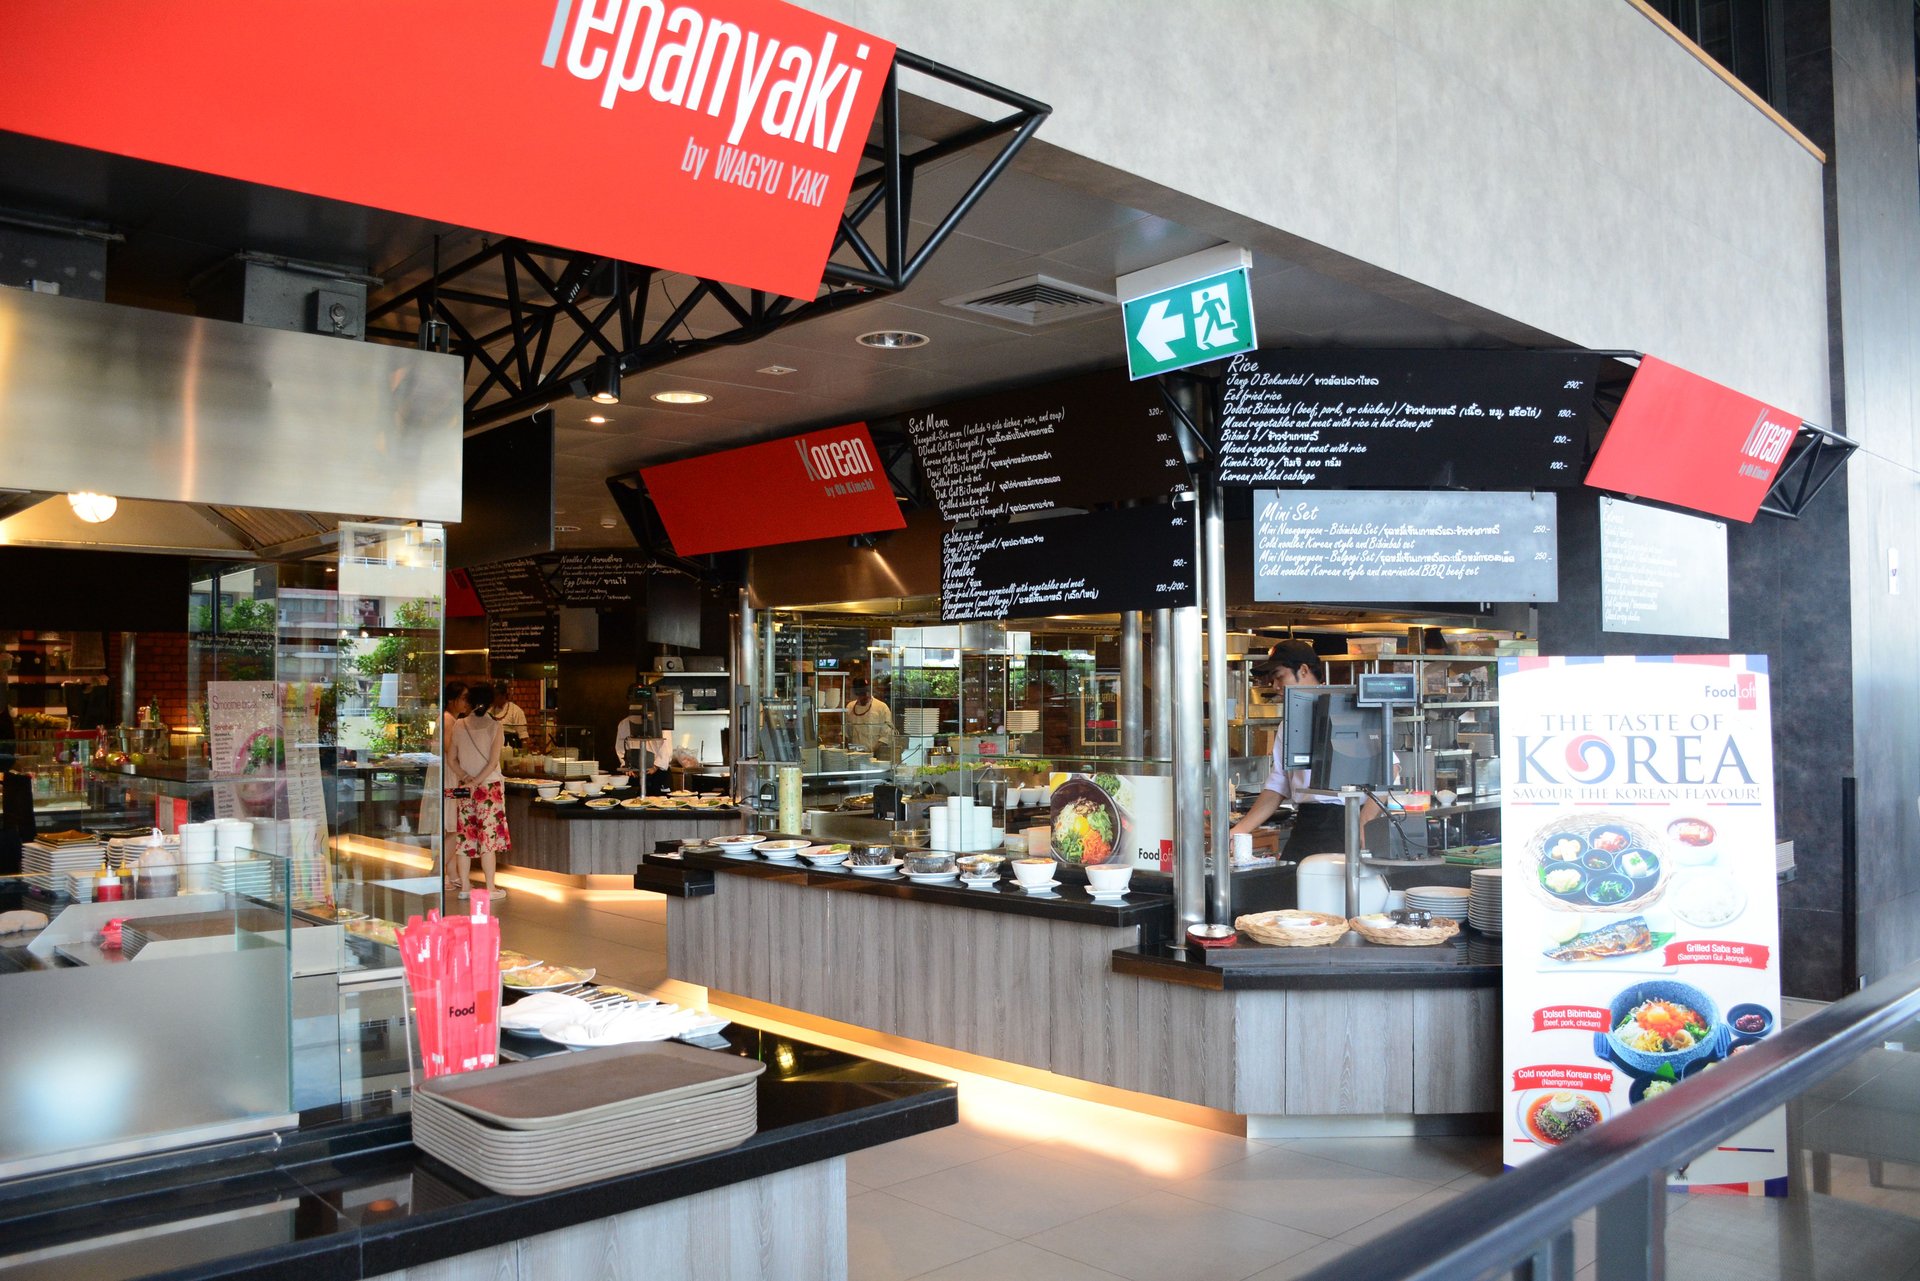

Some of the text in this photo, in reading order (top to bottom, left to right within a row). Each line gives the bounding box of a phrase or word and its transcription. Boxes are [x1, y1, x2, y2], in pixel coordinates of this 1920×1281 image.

[681, 136, 830, 208] by WAGYU YAKI
[1228, 354, 1259, 373] Rice
[1226, 373, 1249, 389] Jang
[1224, 389, 1282, 405] Eel fried rice
[1223, 403, 1253, 415] Dolsot
[1252, 402, 1291, 415] Bibimbab
[1319, 402, 1343, 418] pork,
[1357, 401, 1397, 416] chicken)
[908, 413, 949, 433] Set Menu
[1249, 416, 1293, 432] vegetables
[1296, 416, 1309, 428] and
[1310, 418, 1331, 428] meat
[1332, 417, 1351, 427] with
[1352, 418, 1370, 427] rice
[1371, 418, 1379, 427] in
[1380, 417, 1395, 427] hot
[1394, 419, 1417, 428] stone
[1416, 418, 1434, 432] pot
[1741, 408, 1792, 465] Korean
[1219, 441, 1367, 457] Mixed vegetables and meat with rice
[794, 437, 874, 481] Korean
[1220, 455, 1251, 467] Kimchi
[1250, 457, 1267, 467] 300
[1219, 469, 1315, 485] Korean pickled cabbage
[1259, 502, 1319, 521] Mini Set
[1258, 523, 1278, 535] Mini
[1329, 523, 1362, 535] Bibimbab
[1363, 523, 1379, 535] Set
[1259, 537, 1415, 552] Cold noodles Korean style and Bibimbab set
[1258, 550, 1278, 562] Mini
[1360, 550, 1376, 562] Set
[943, 561, 976, 579] Noodles
[1259, 564, 1479, 580] Cold noodles Korean style and marinated BBQ beef set
[563, 578, 575, 587] Egg
[1705, 683, 1736, 698] Food
[1541, 714, 1724, 731] THE TASTE OF
[1513, 734, 1760, 784] KOREA
[1512, 787, 1760, 800] SAVOUR THE KOREAN FLAVOUR!
[1138, 848, 1160, 861] Food
[1686, 943, 1744, 954] Grilled Saba set
[449, 1002, 475, 1018] Food
[1542, 1009, 1601, 1019] Dolsot Bibimbab
[1518, 1070, 1611, 1082] Cold noodles Korean style
